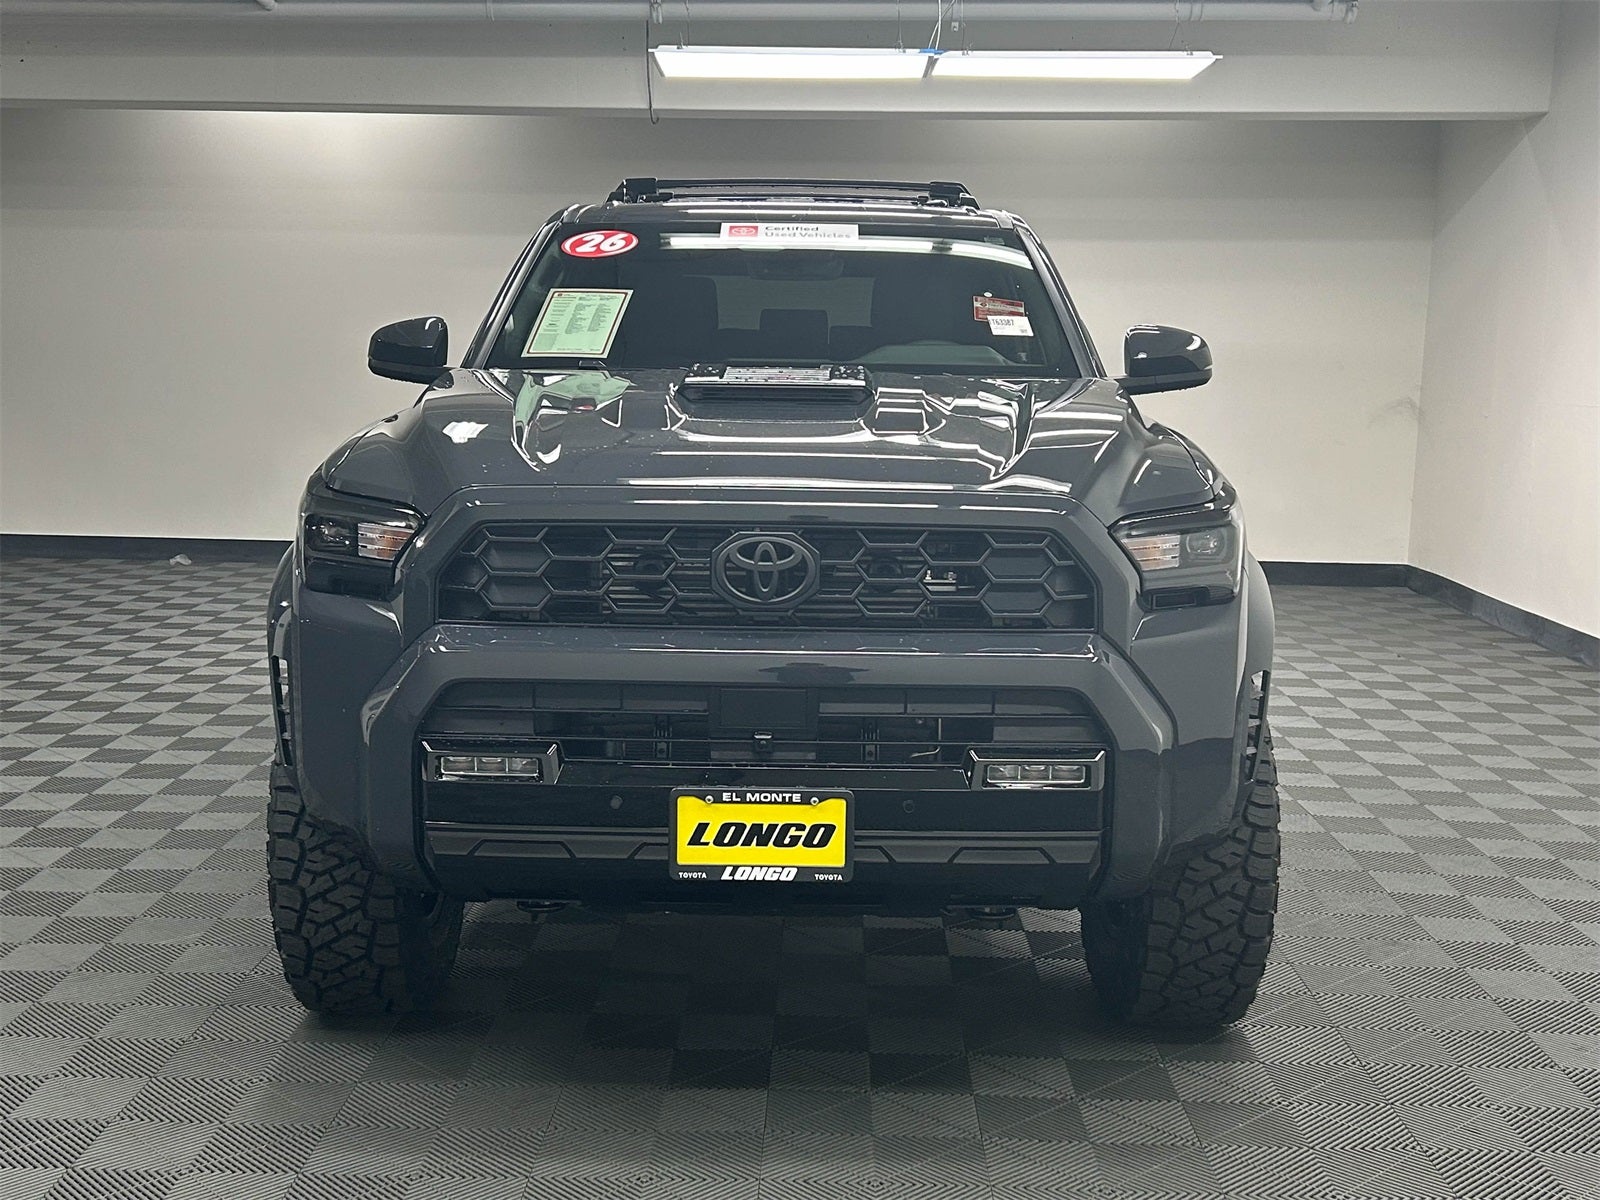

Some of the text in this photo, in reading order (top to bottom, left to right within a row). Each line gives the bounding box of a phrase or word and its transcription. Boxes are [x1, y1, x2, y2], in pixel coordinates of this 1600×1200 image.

[576, 233, 626, 252] 26
[722, 793, 801, 803] EL MONTE
[687, 822, 837, 848] LONGO
[720, 866, 798, 881] LONGO
[814, 873, 843, 881] TOYOTA
